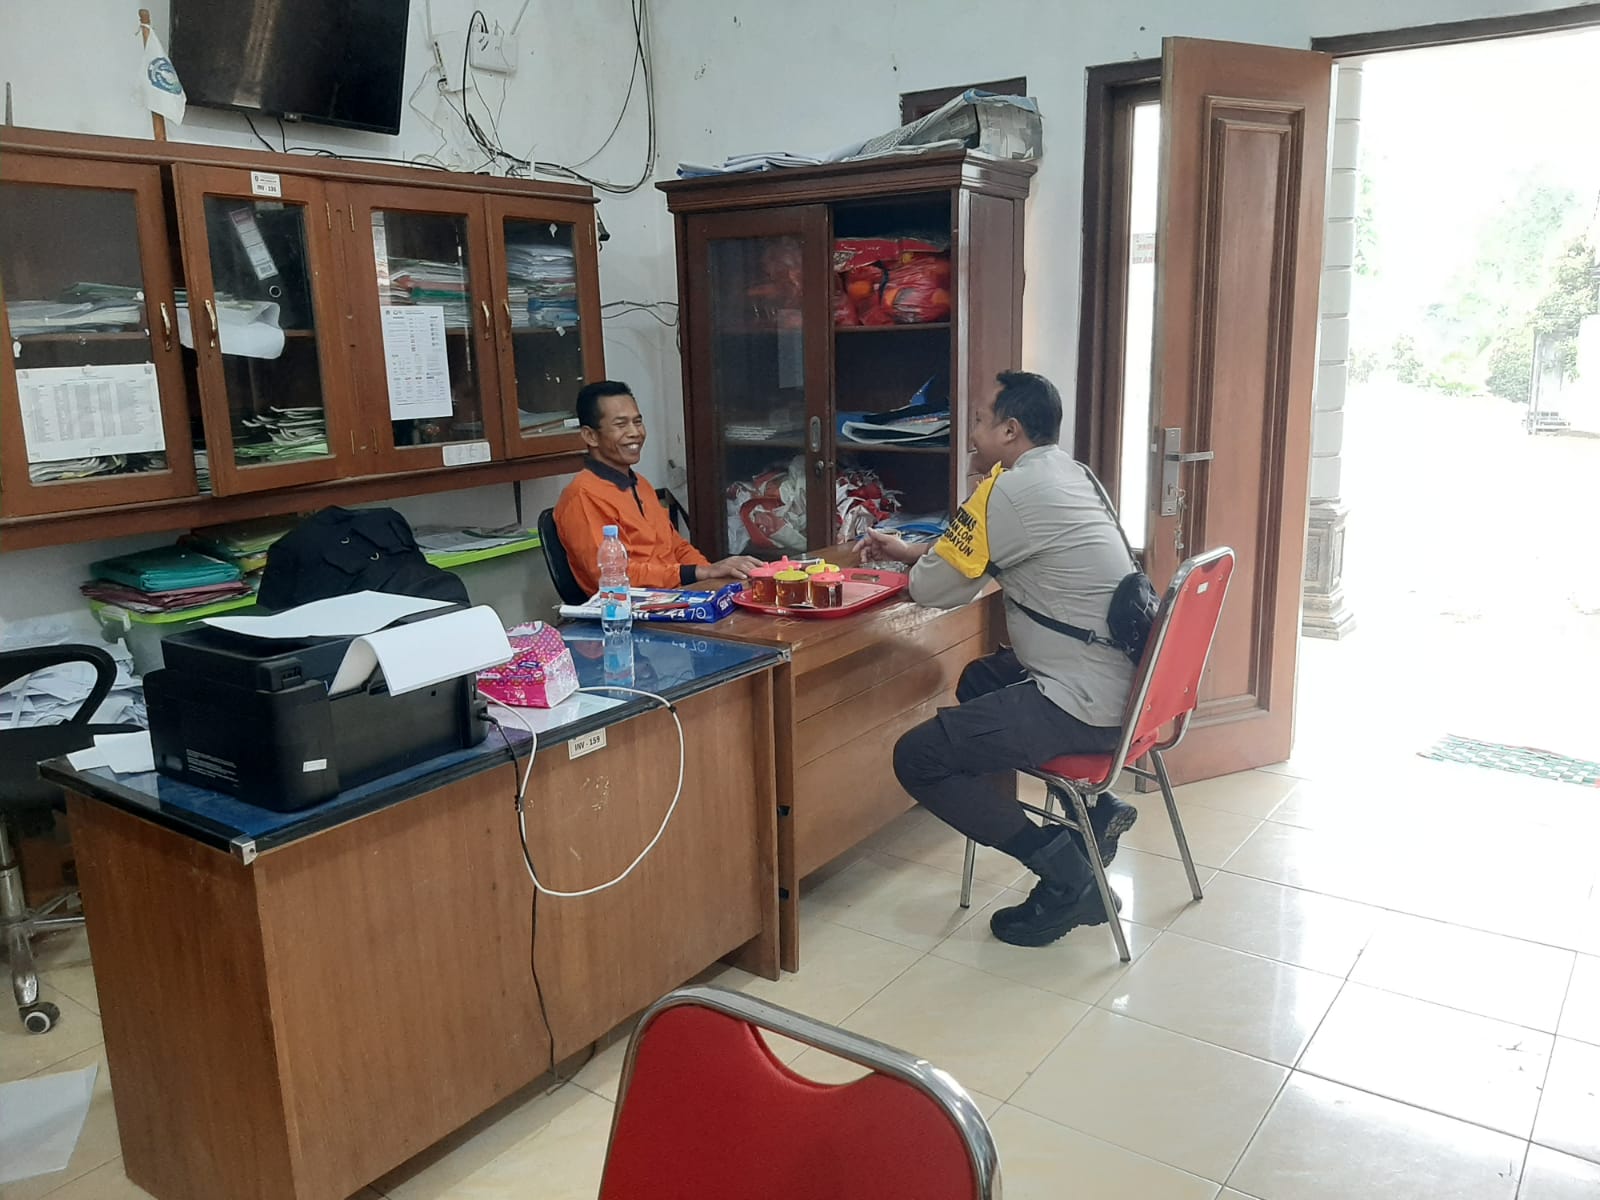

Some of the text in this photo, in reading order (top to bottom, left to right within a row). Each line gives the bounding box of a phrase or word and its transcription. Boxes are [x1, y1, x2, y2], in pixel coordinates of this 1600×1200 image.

[957, 527, 974, 545] LOR
[688, 606, 707, 620] 70
[574, 741, 585, 752] INV
[589, 735, 601, 746] 159
